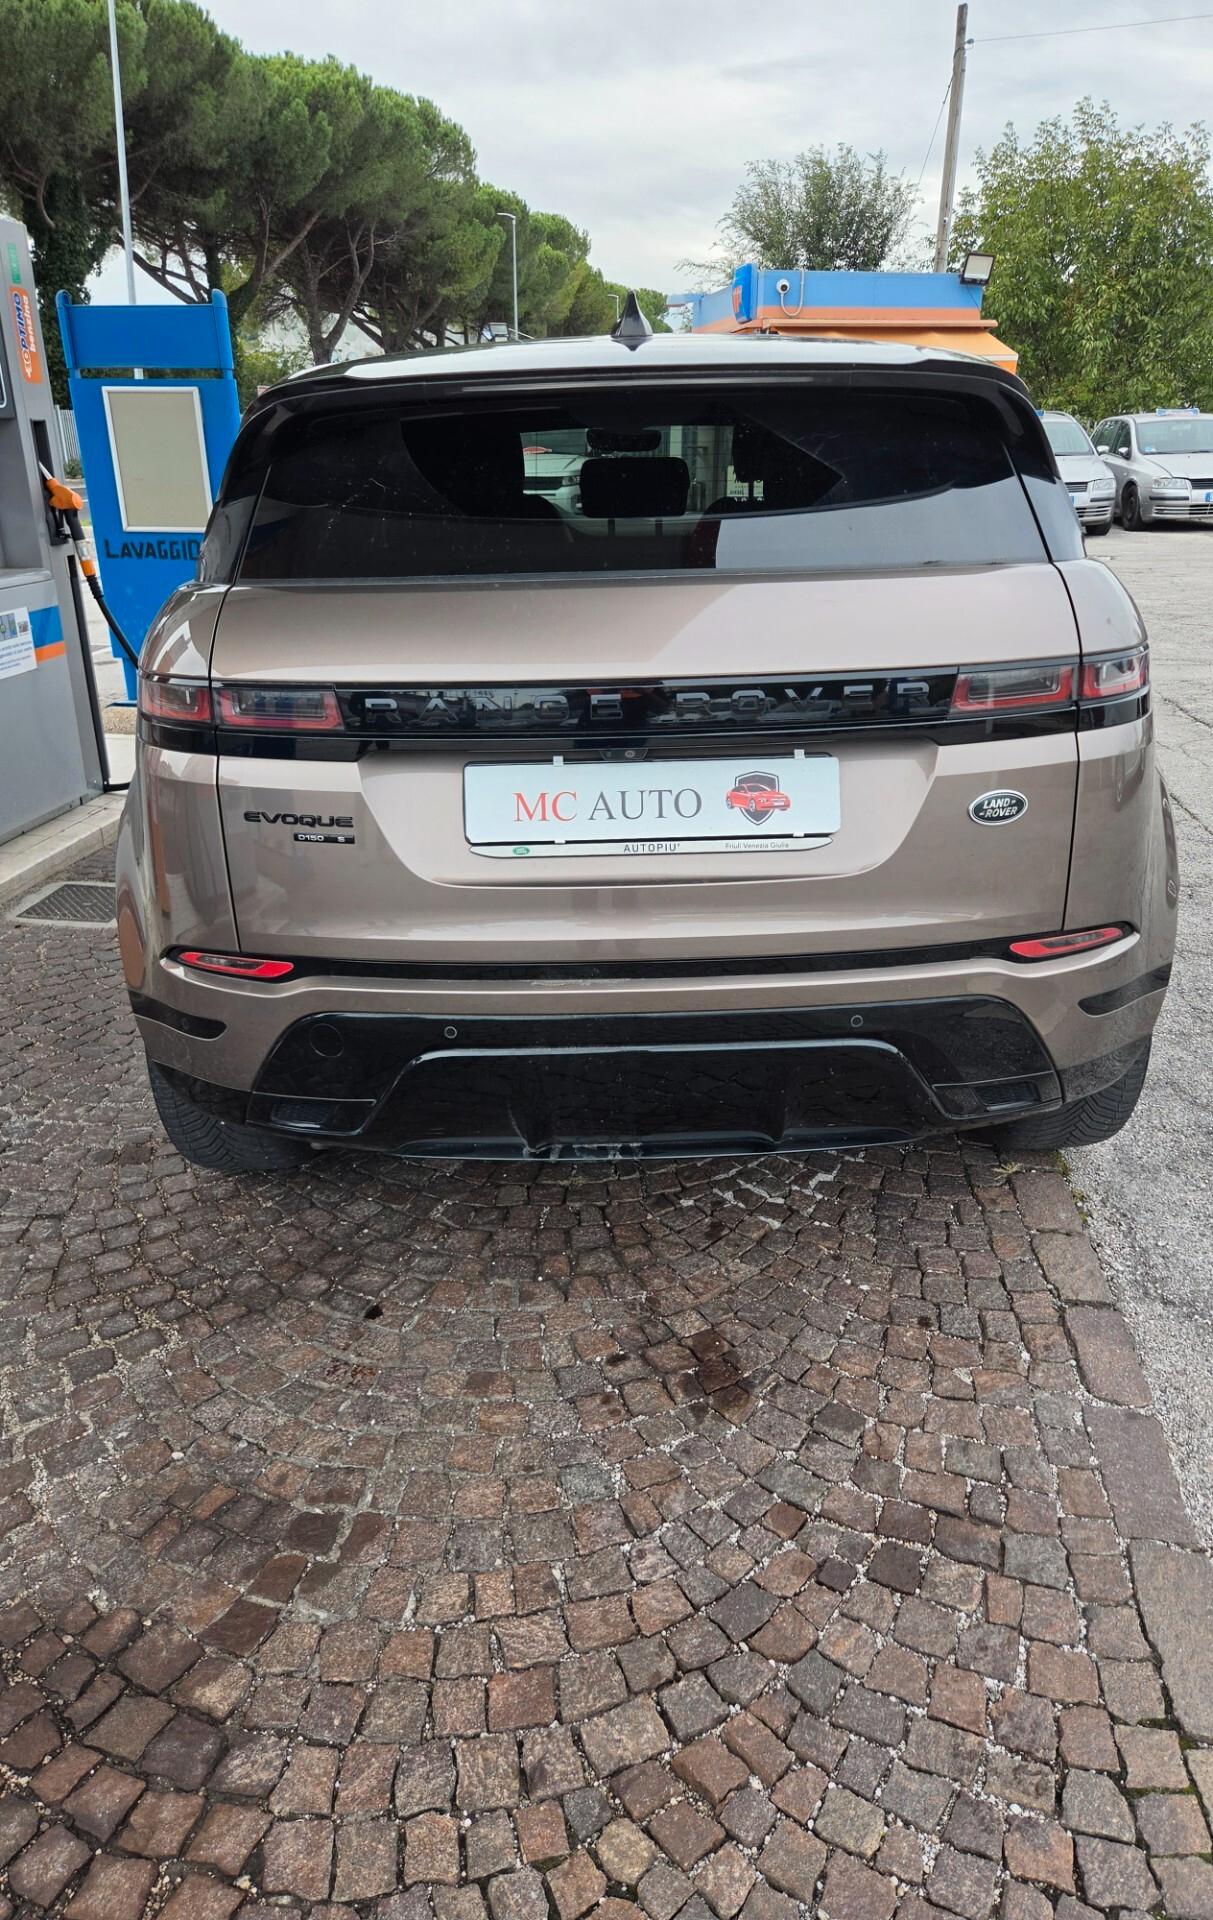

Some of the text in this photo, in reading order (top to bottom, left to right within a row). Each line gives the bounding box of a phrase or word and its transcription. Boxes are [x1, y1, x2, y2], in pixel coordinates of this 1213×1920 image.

[23, 295, 36, 352] benzina
[104, 539, 201, 561] LAVAGGIO
[364, 681, 931, 723] RANGE ROVER
[243, 810, 354, 828] EVOQUE
[513, 788, 702, 822] MC AUTO
[297, 834, 325, 842] D150
